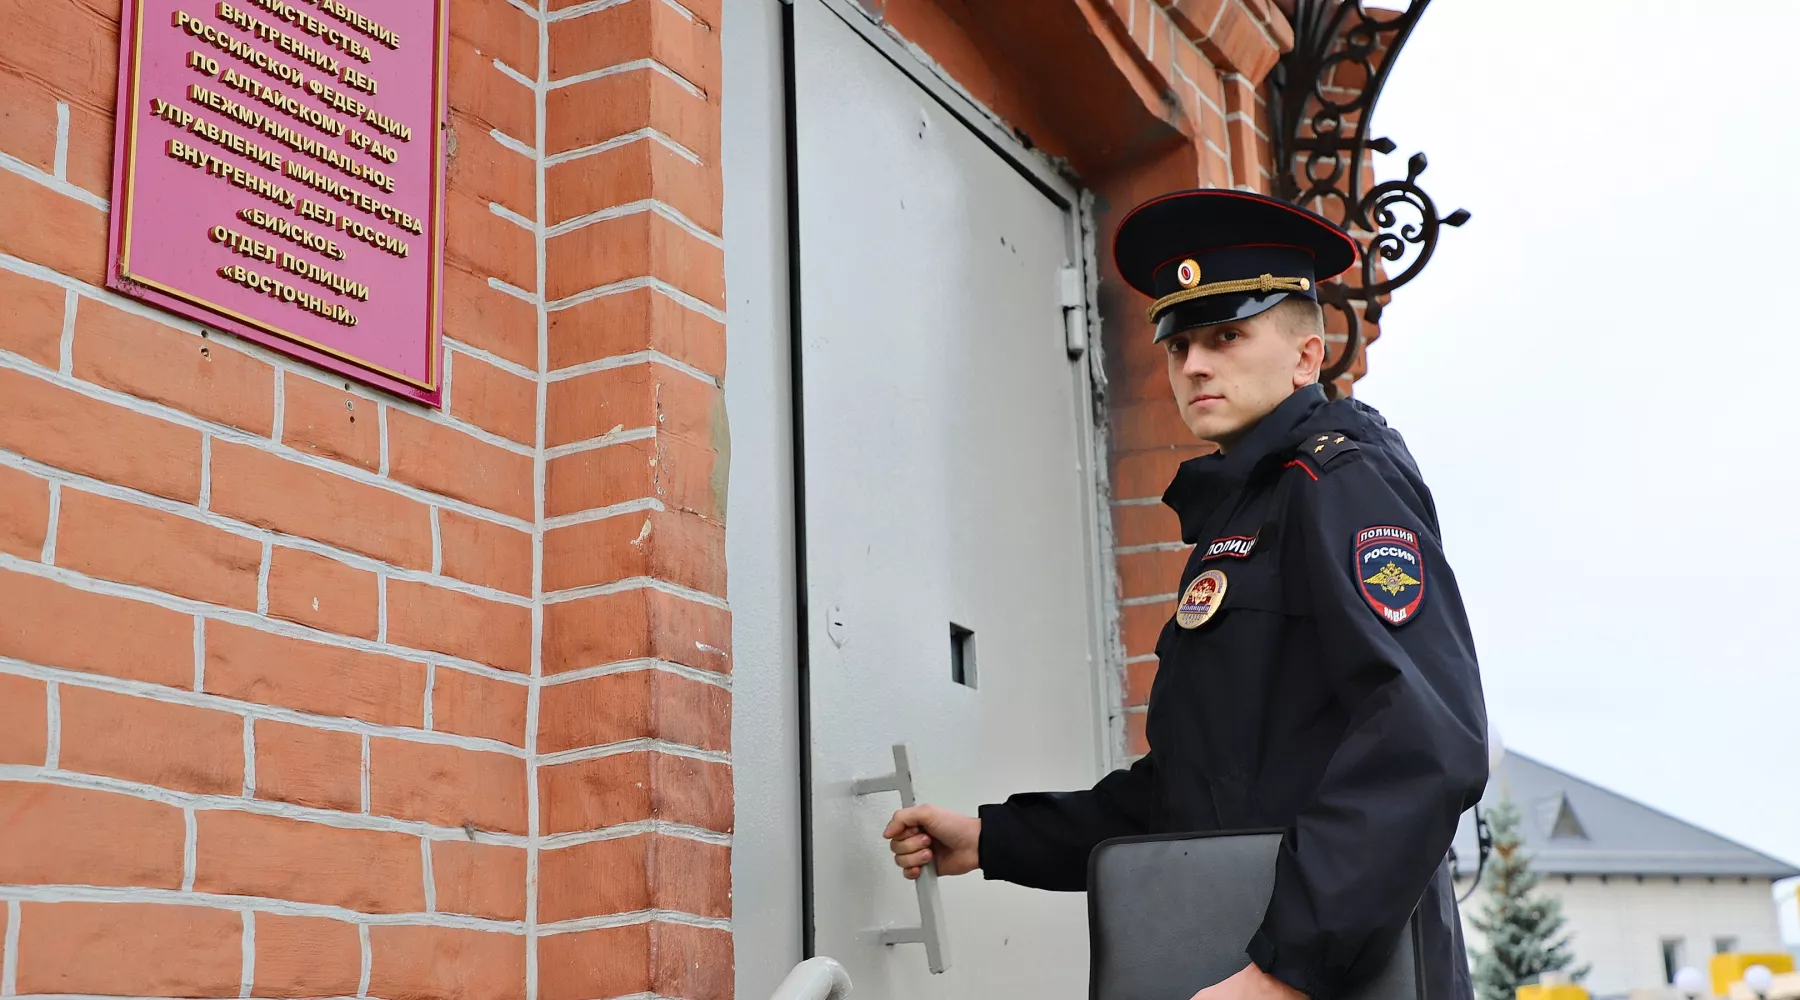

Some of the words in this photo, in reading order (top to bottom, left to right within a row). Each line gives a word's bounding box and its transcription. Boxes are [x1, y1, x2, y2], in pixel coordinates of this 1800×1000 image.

[220, 1, 339, 75] ВНУТРЕННИХ
[343, 67, 378, 94] ДЕЛ
[258, 0, 372, 61] ИСТЕРСТВА
[313, 0, 400, 48] АВЛЕНИЕ
[177, 10, 304, 86] РОССИЙСКОЙ
[307, 79, 412, 140] ФЕДЕРАЦИИ
[191, 50, 219, 75] ПО
[223, 68, 346, 136] АЛТАЙСКОМУ
[350, 129, 398, 163] КРАЮ
[155, 97, 282, 170] УПРАВЛЕНИЕ
[287, 160, 423, 234] МИНИСТЕРСТВА
[192, 83, 396, 192] МЕЖМУНИЦИПАЛЬНОЕ
[171, 139, 296, 208] ВНУТРЕННИХ
[300, 199, 336, 225] ДЕЛ
[341, 216, 409, 257] РОССИИ
[212, 225, 277, 263] ОТДЕЛ
[282, 252, 369, 300] ПОЛИЦИИ
[241, 208, 347, 260] «БИЙСКОЕ»
[221, 264, 359, 325] «ВОСТОЧНЫЙ»
[1360, 528, 1414, 542] ПОЛИЦИЯ
[1364, 547, 1415, 565] РОССИЯ
[1384, 606, 1407, 622] МВД
